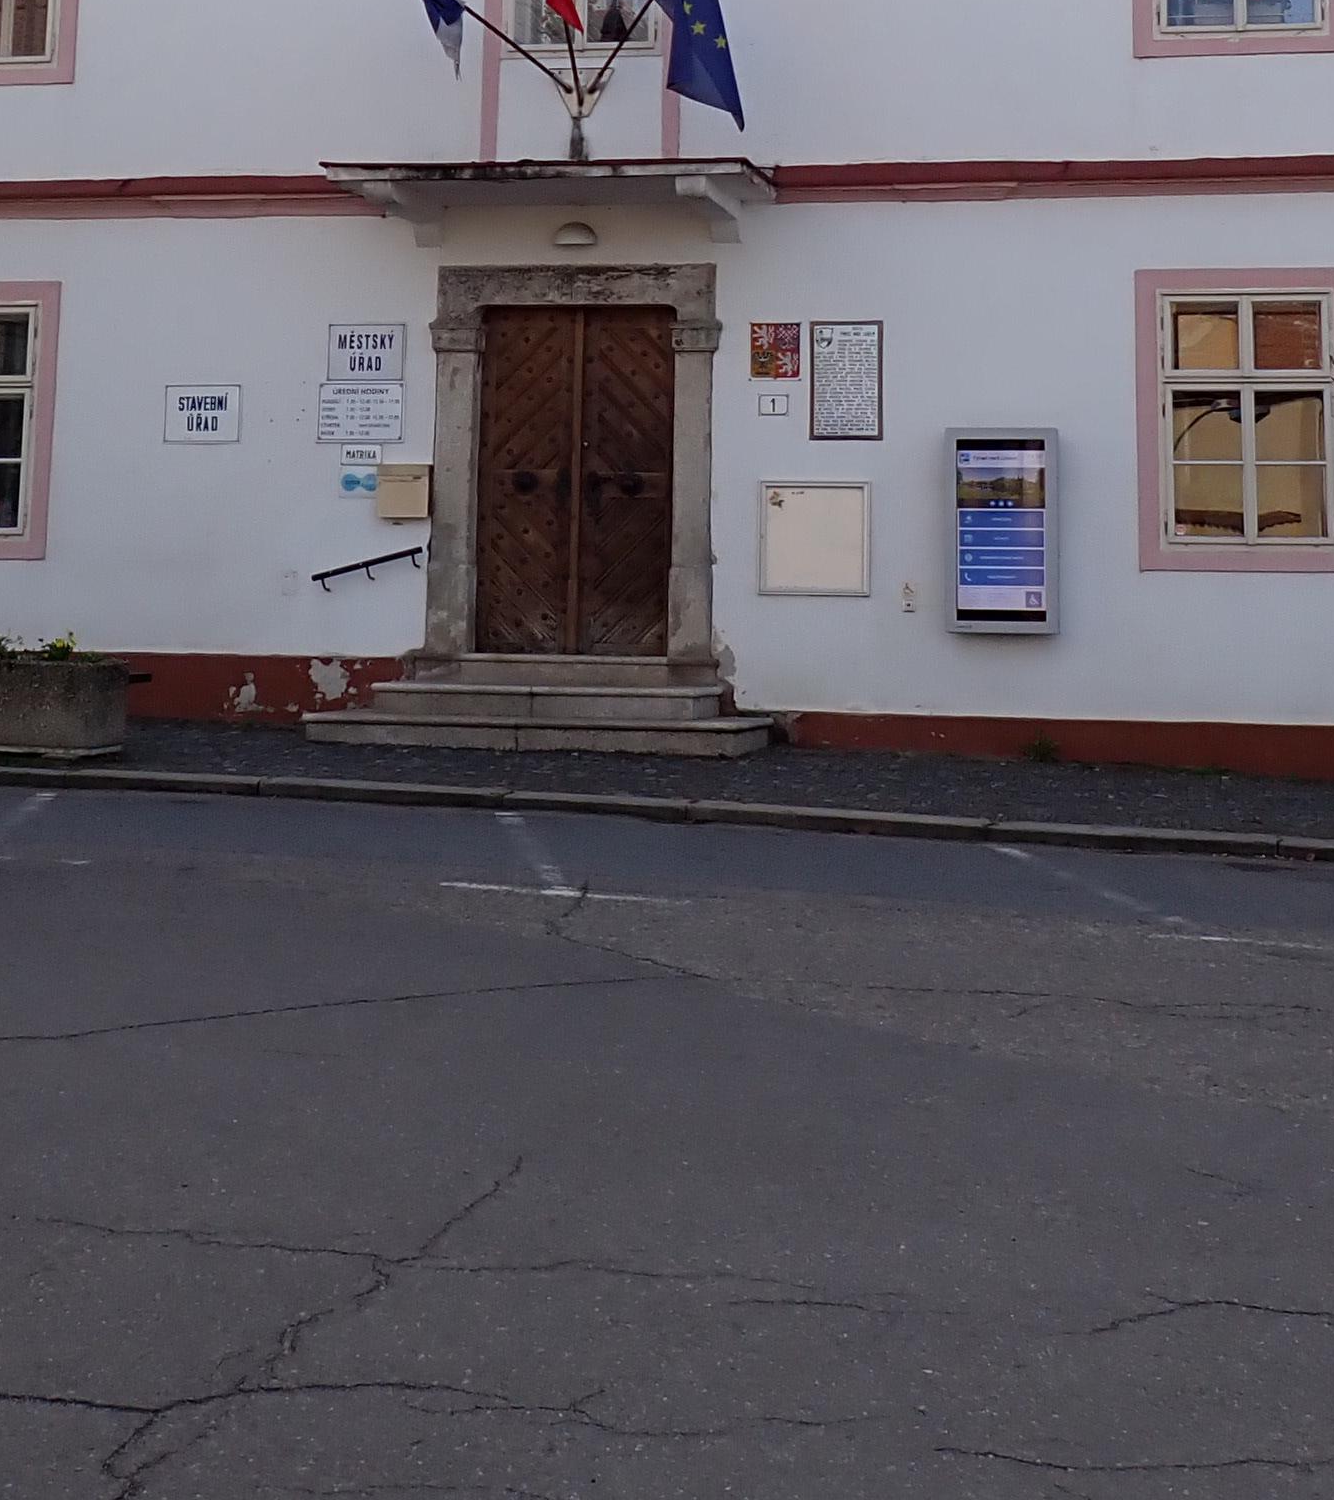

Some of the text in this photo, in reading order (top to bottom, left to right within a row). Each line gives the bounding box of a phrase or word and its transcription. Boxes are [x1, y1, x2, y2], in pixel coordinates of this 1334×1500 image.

[338, 330, 395, 349] MĚSTSKÝ
[349, 352, 382, 372] ÚŘAD
[178, 392, 228, 412] STAVEBNÍ
[770, 398, 777, 413] 1
[187, 413, 218, 432] ÚŘAD
[345, 450, 377, 460] MATRIKA
